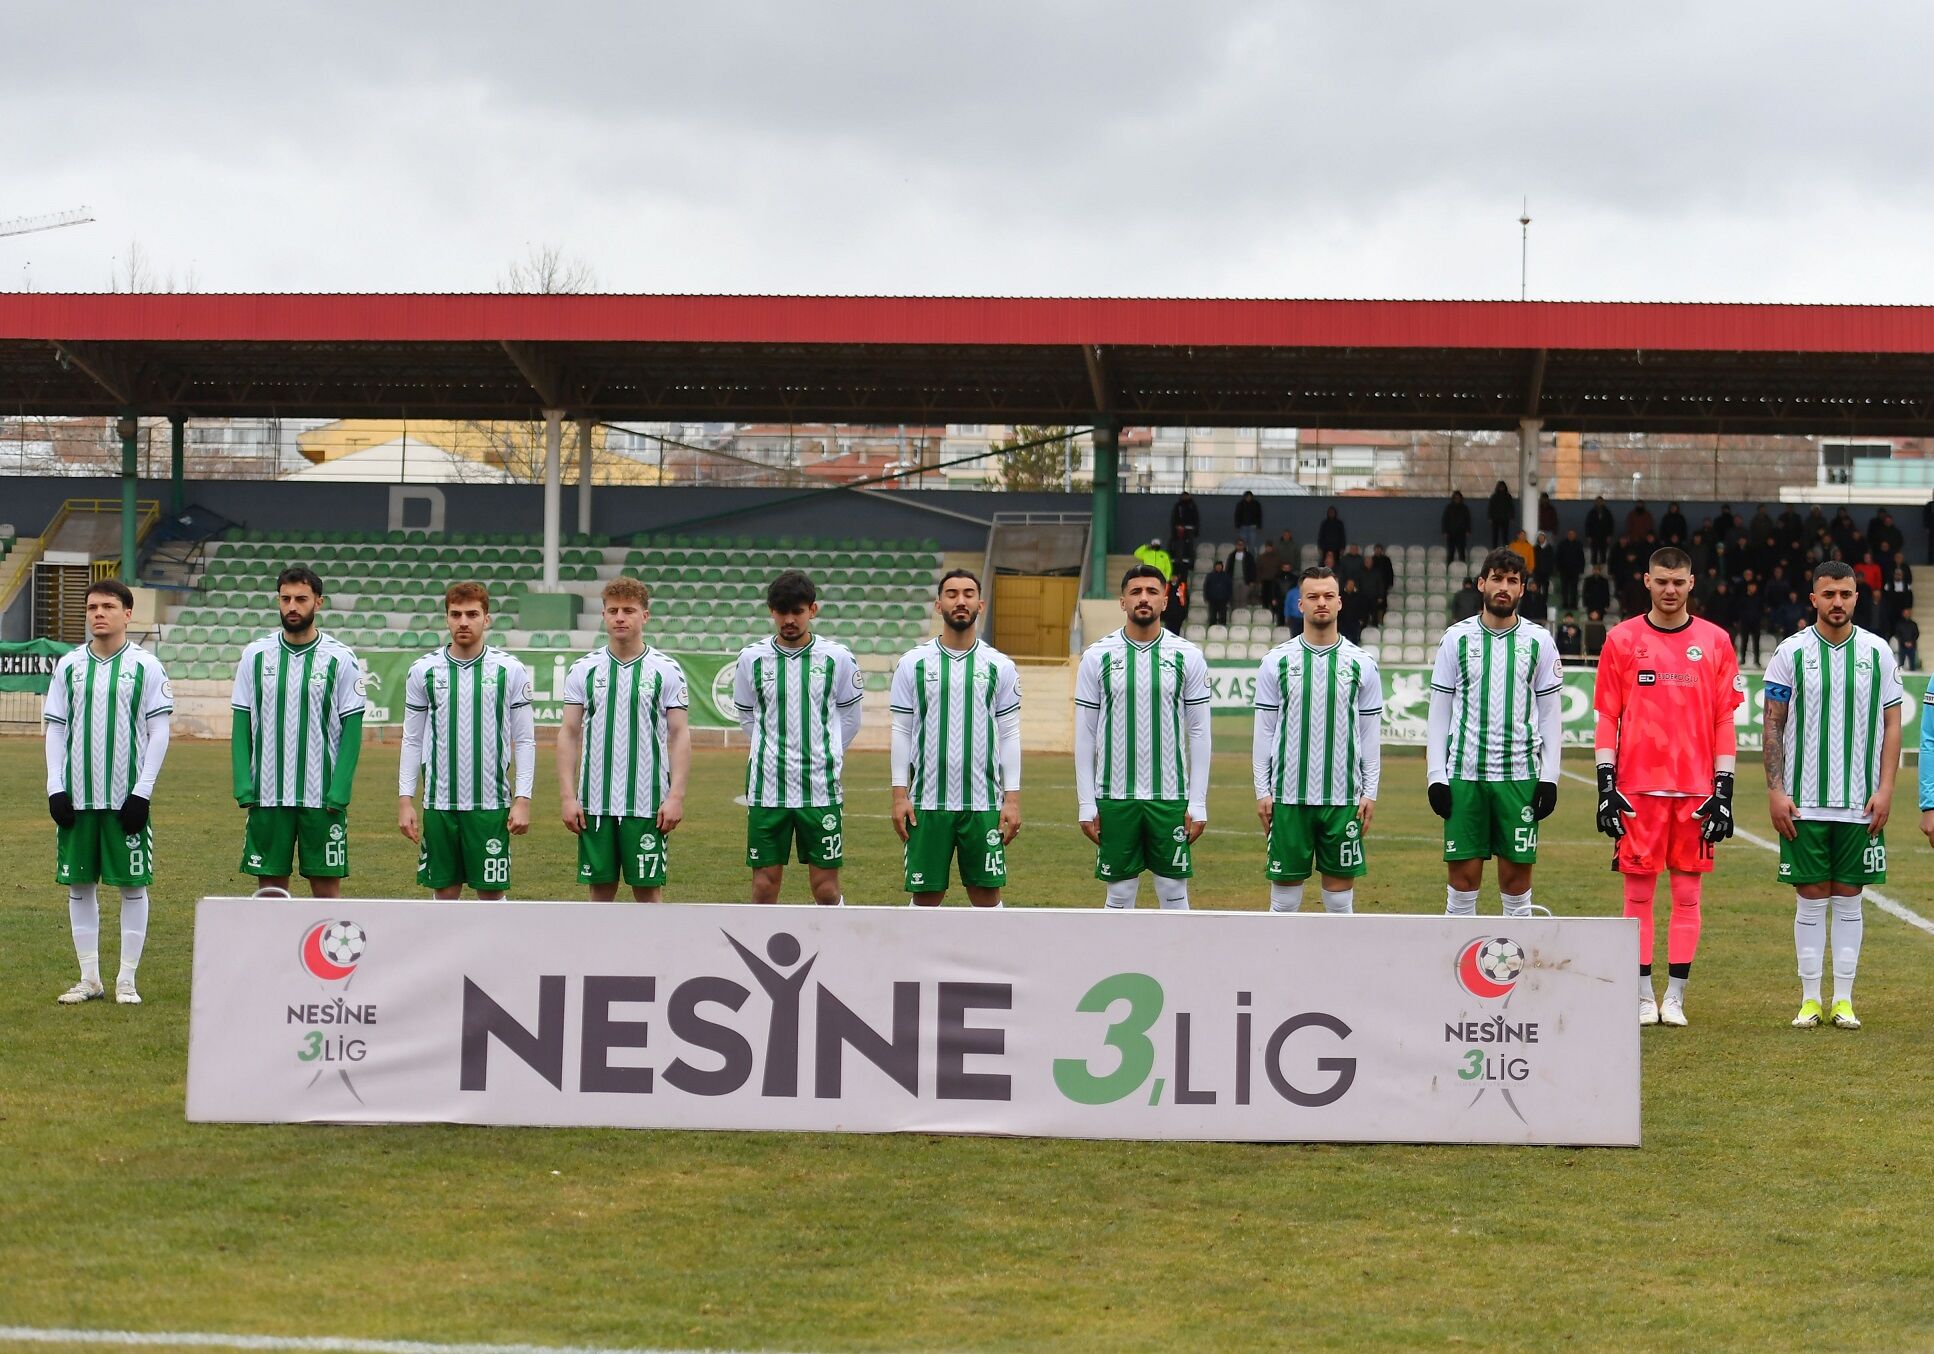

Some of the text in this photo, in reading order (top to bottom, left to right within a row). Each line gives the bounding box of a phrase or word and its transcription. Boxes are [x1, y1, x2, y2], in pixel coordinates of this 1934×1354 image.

[388, 486, 446, 535] D
[325, 839, 346, 867] 66
[821, 833, 843, 860] 32
[1340, 839, 1363, 867] 69
[1514, 827, 1537, 853] 54
[129, 849, 145, 876] 8
[483, 858, 508, 883] 88
[636, 853, 659, 879] 17
[985, 850, 1004, 876] 45
[1172, 846, 1189, 872] 4
[1863, 845, 1887, 873] 98
